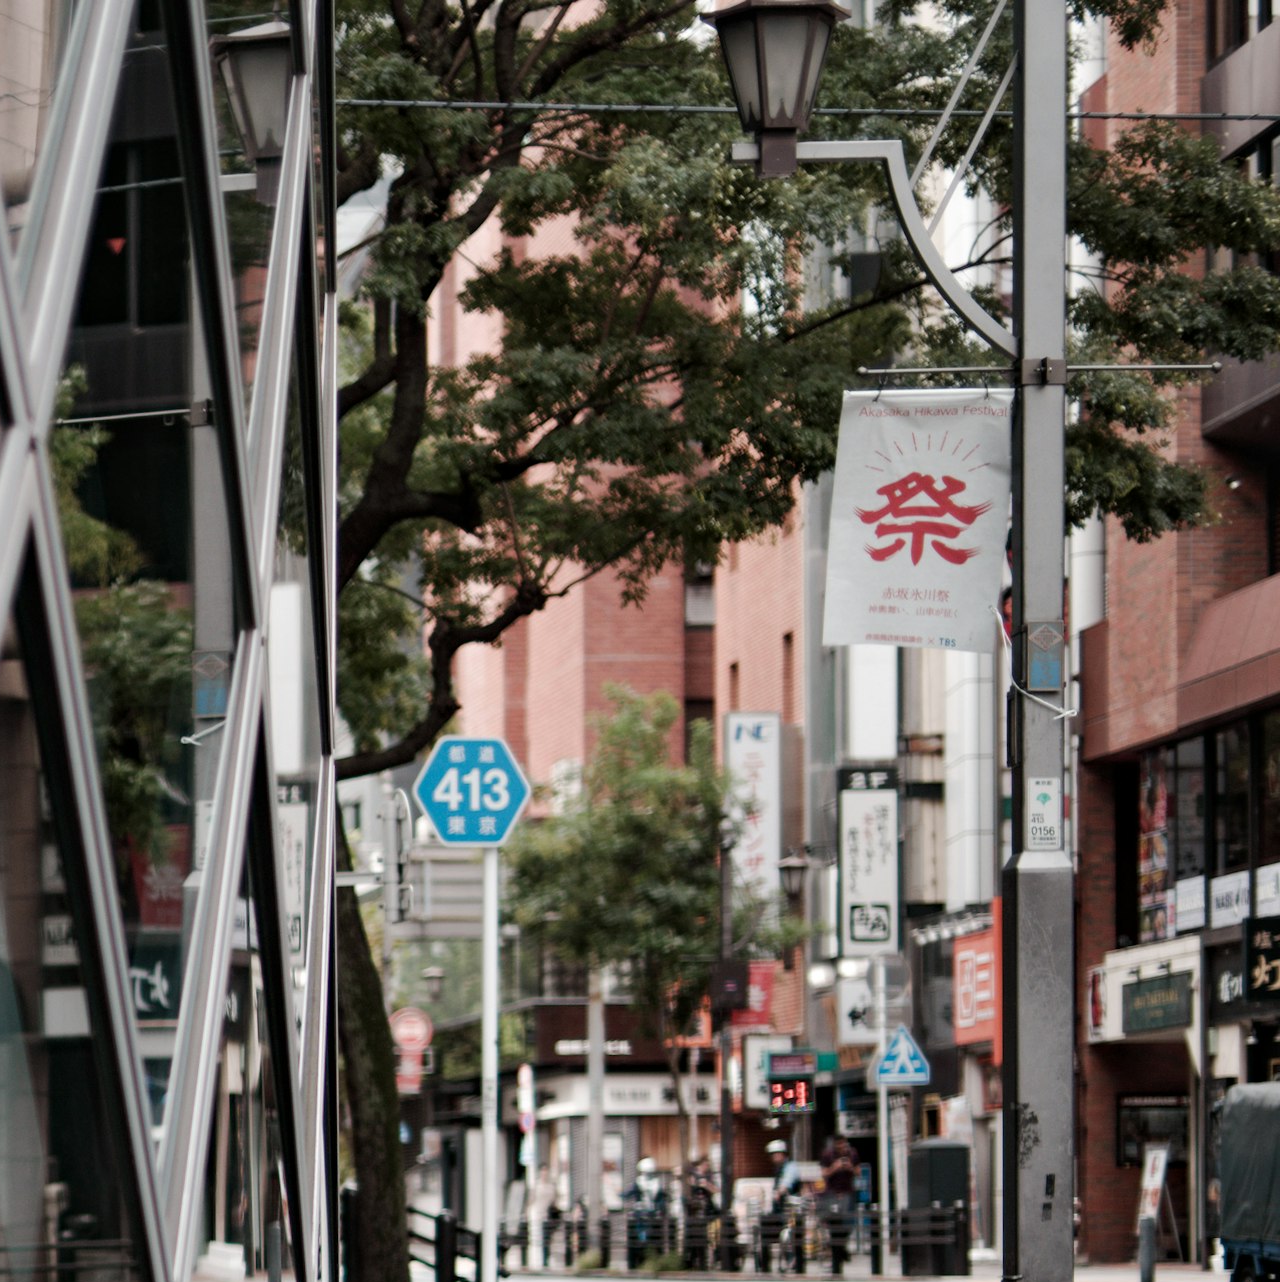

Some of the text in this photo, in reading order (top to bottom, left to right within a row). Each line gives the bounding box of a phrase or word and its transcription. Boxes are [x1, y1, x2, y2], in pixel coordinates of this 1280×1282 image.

[859, 405, 1008, 418] Akasaka Hikawa Festival
[853, 471, 993, 566] 祭
[939, 637, 957, 648] TBS
[432, 767, 510, 812] 413
[447, 815, 497, 836] 東京
[1031, 825, 1056, 837] 0156
